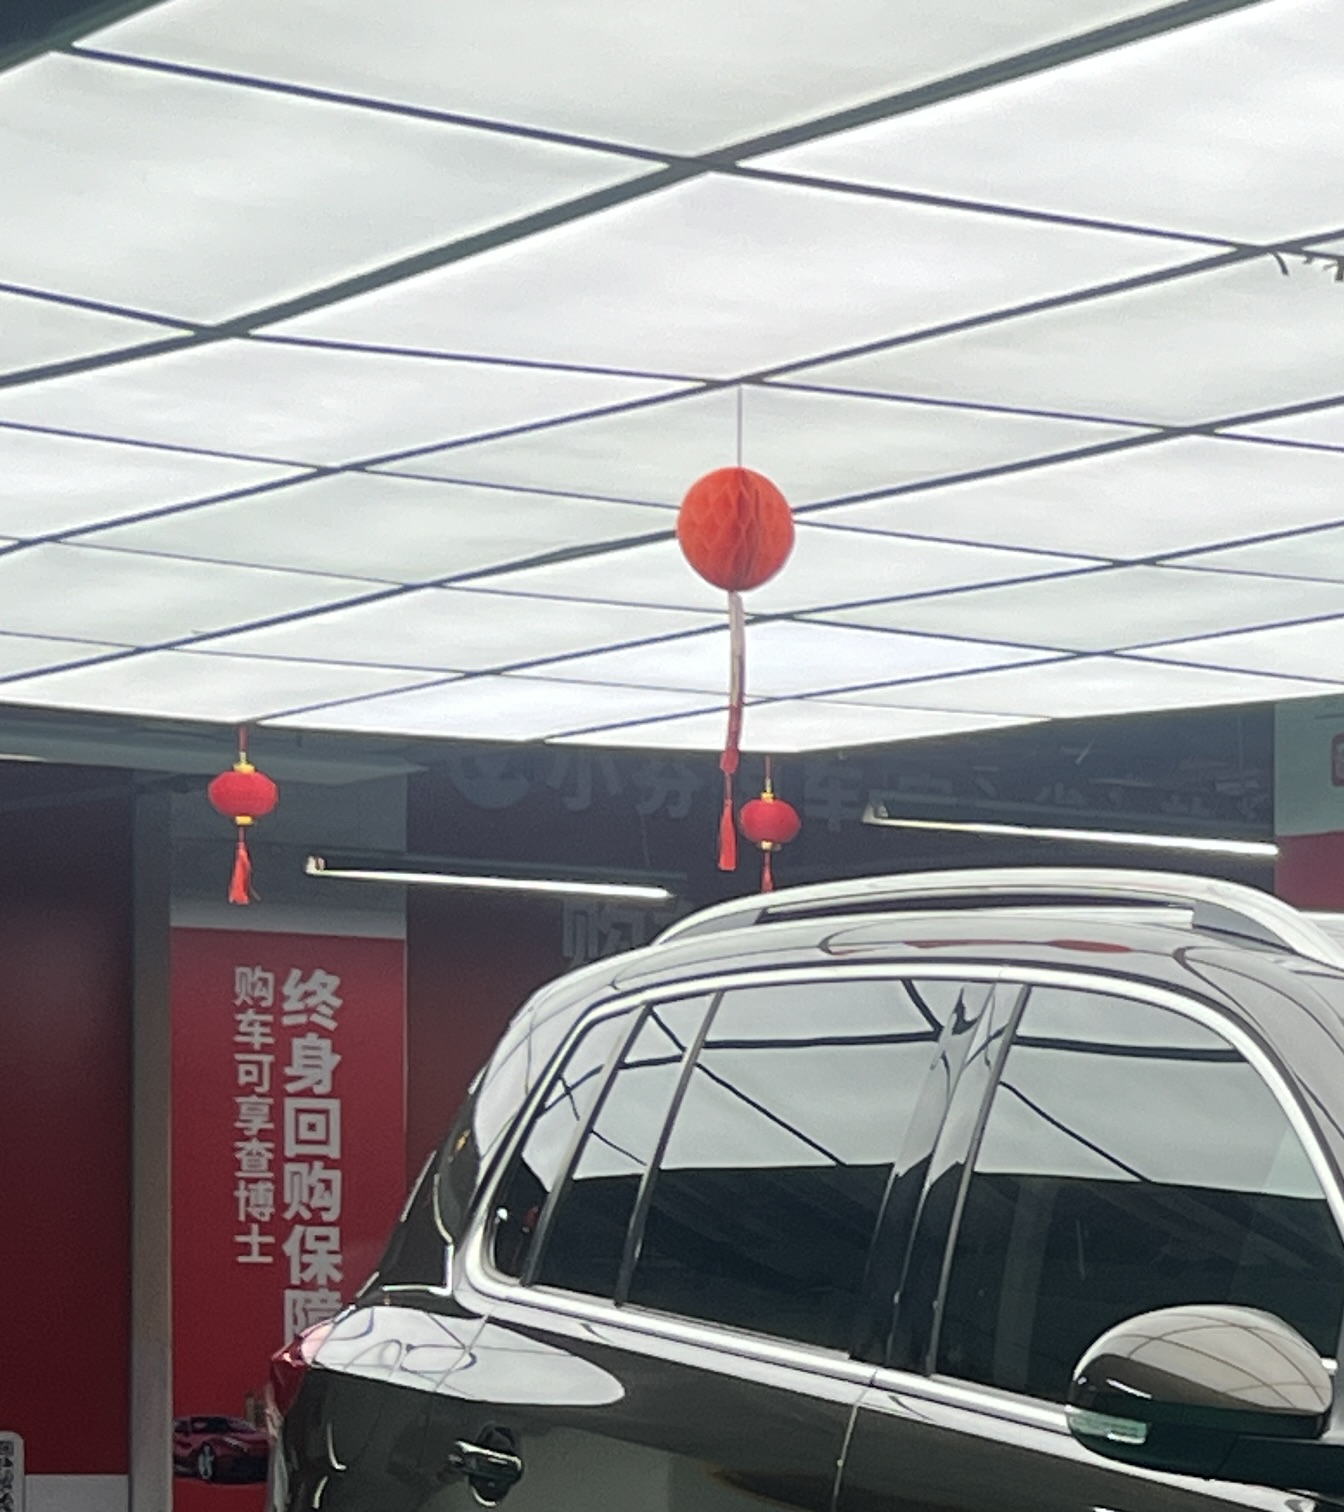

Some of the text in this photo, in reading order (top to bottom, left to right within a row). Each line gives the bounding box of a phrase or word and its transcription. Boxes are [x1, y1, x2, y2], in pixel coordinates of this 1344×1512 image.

[233, 964, 275, 1265] 购车可享查博士
